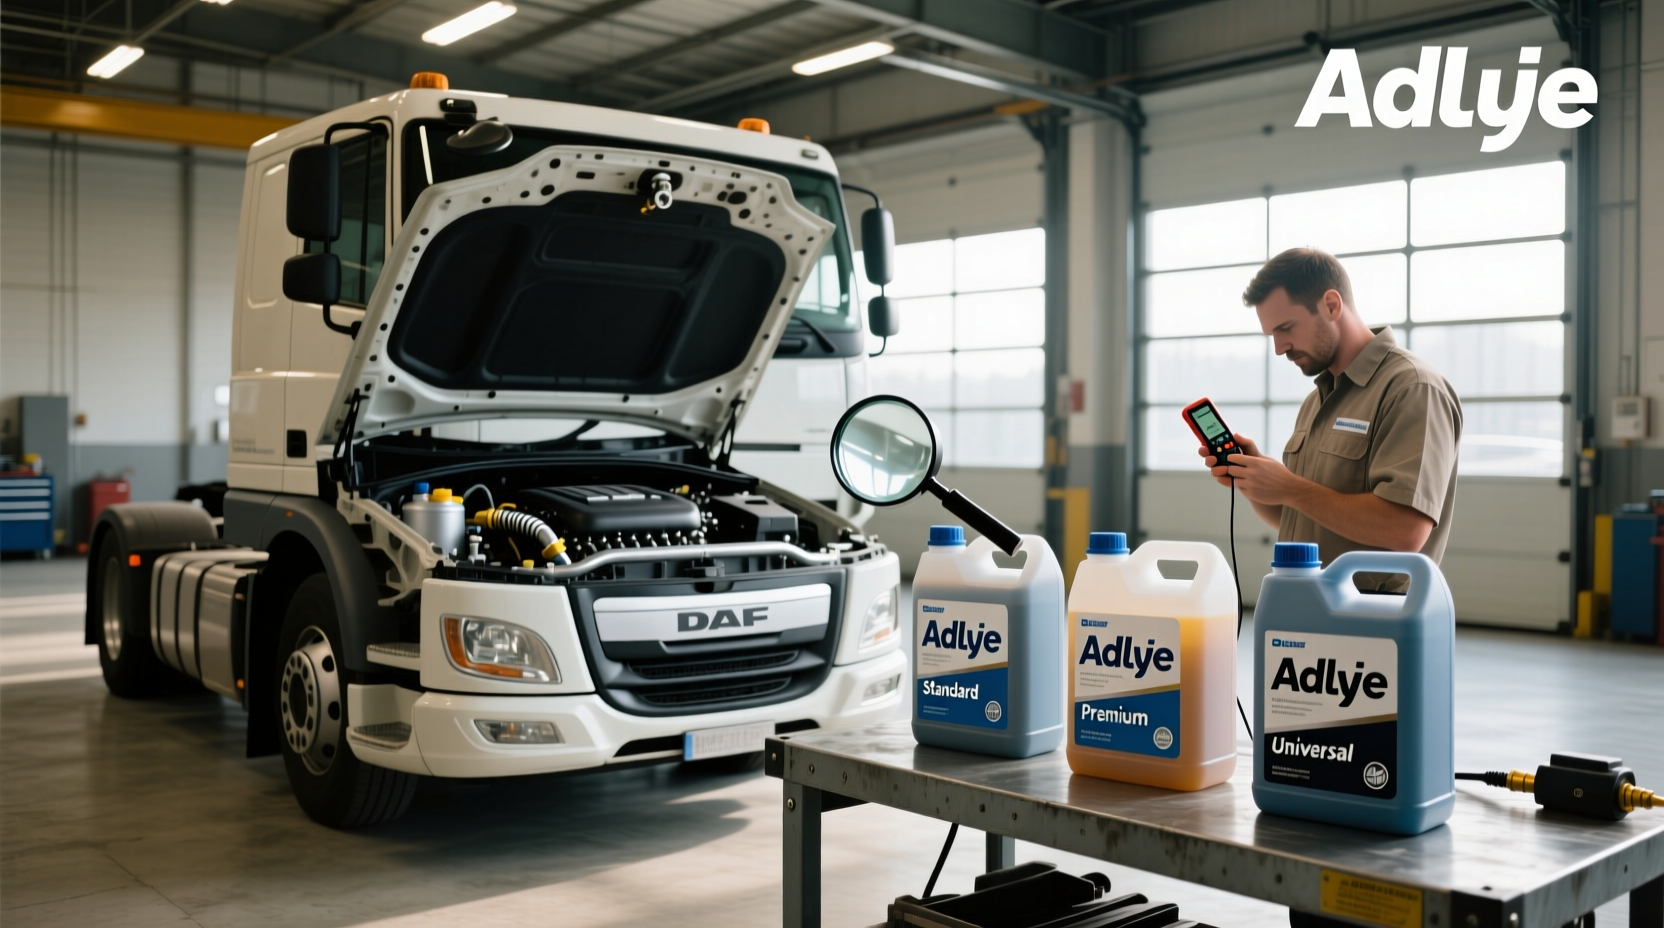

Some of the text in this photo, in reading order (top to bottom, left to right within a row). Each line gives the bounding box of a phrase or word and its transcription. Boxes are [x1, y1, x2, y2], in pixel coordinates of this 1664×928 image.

[677, 606, 769, 633] DAF
[922, 680, 979, 700] Standard
[1081, 703, 1149, 726] Premium
[1271, 735, 1354, 763] Universal
